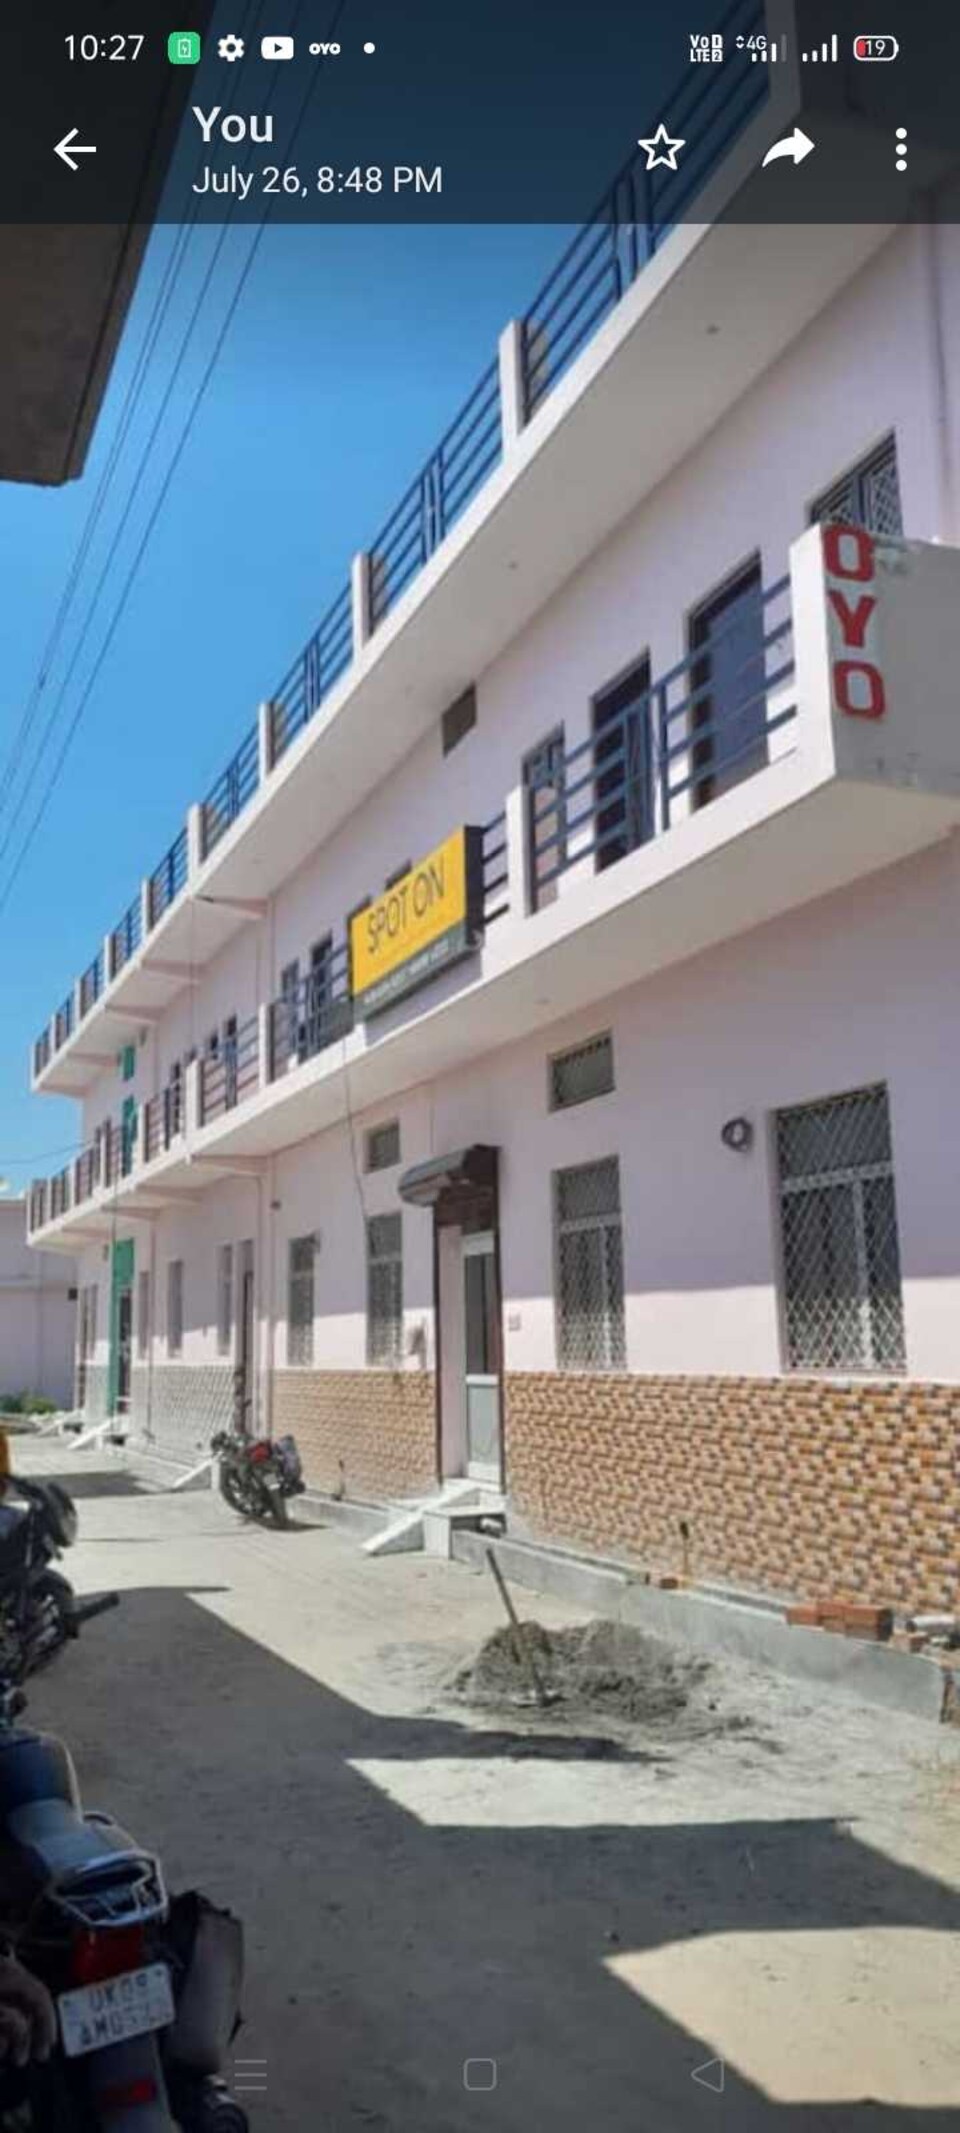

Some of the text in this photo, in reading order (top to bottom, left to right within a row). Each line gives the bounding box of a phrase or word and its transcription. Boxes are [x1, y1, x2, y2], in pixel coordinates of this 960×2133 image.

[822, 524, 886, 720] OYO
[367, 854, 445, 954] SPOT ON
